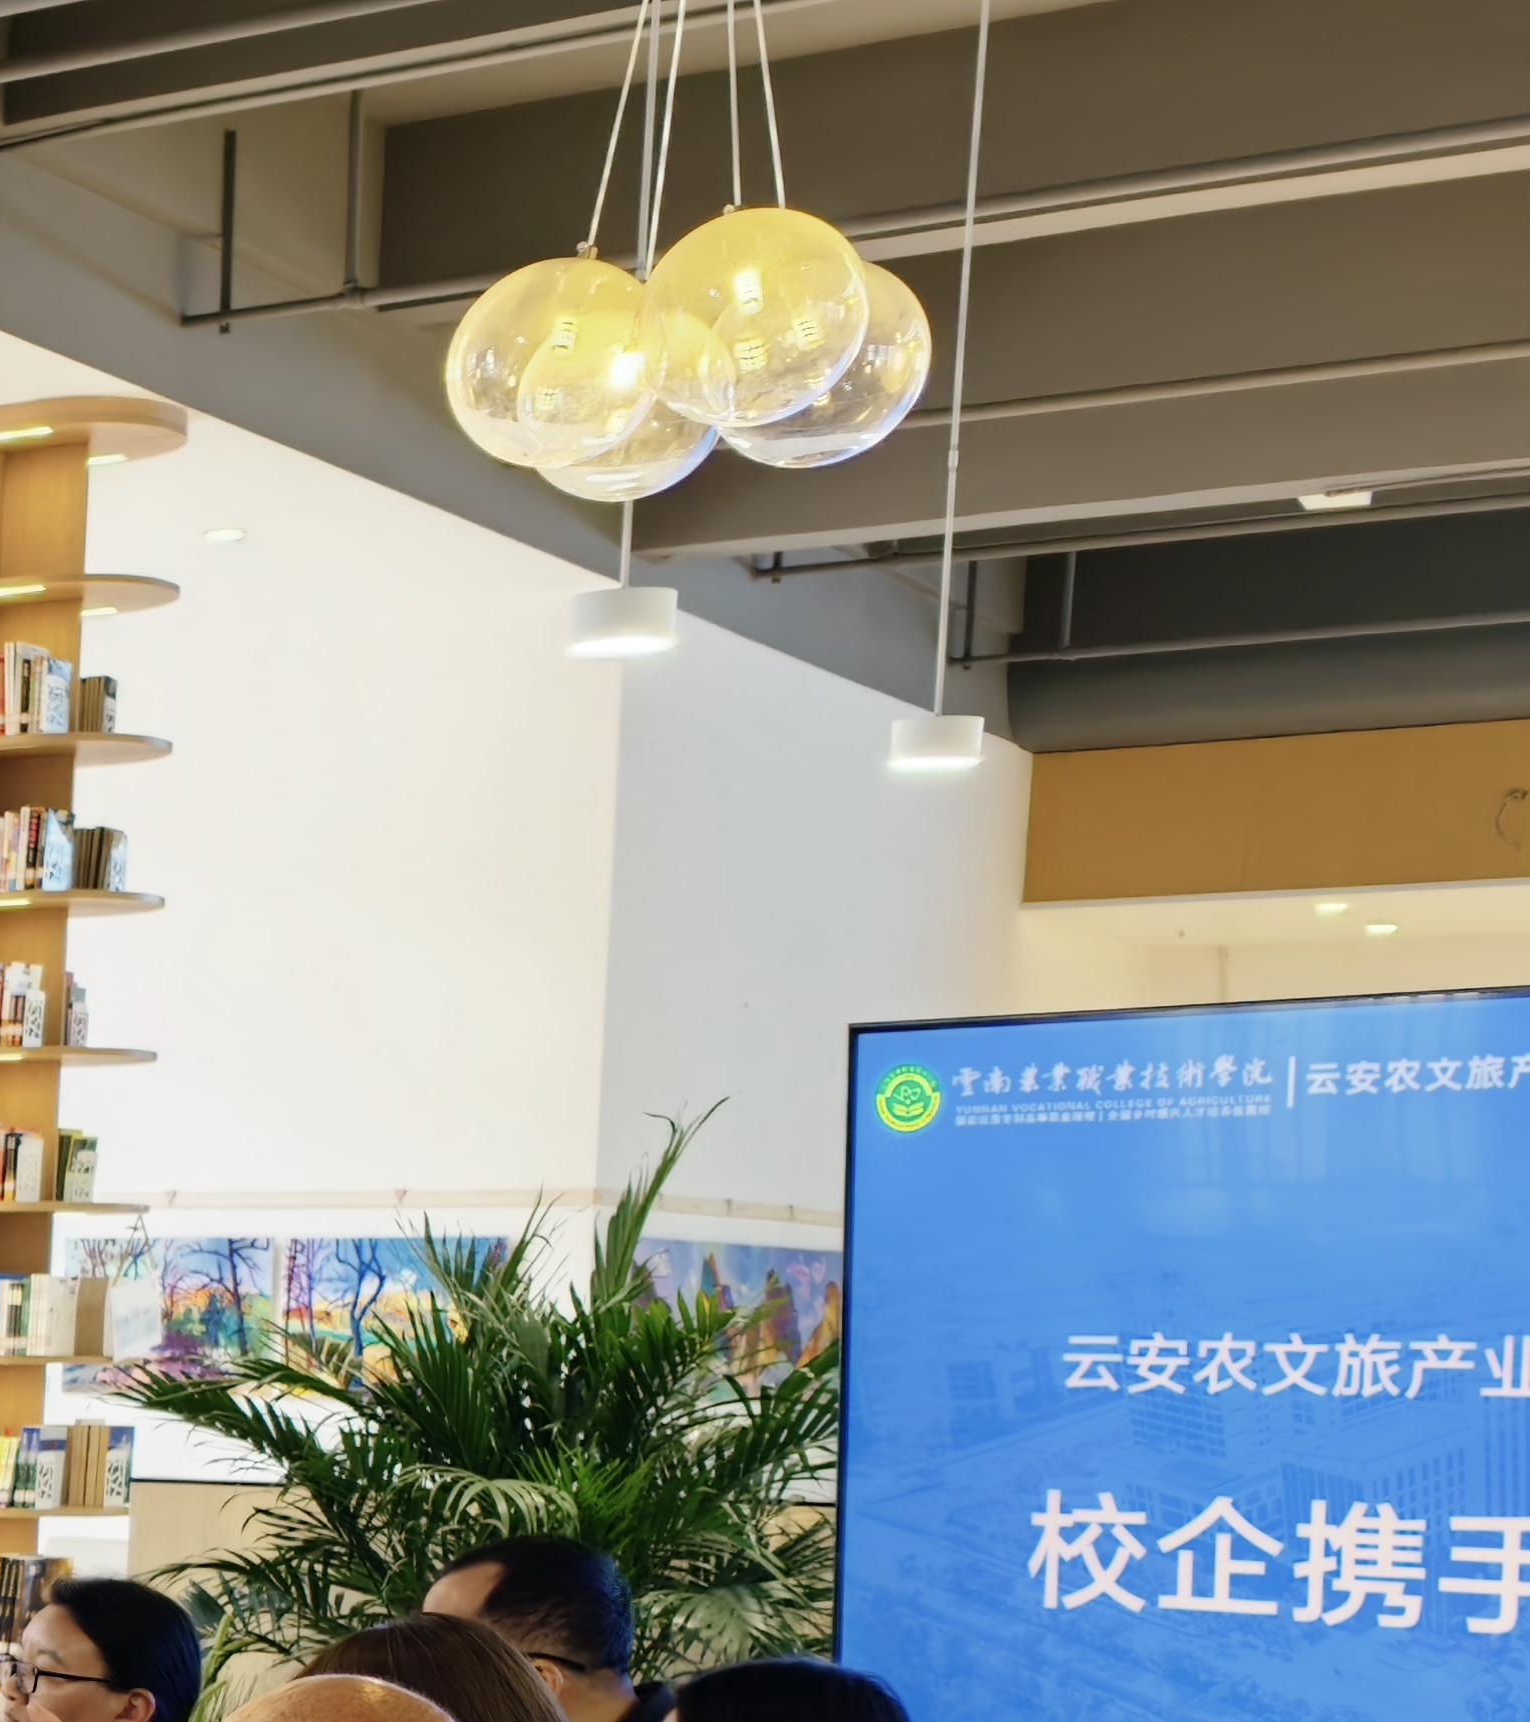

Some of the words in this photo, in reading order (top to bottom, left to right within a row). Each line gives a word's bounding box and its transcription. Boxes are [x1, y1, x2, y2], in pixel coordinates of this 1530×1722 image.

[955, 1104, 1008, 1115] YUNNAN
[1011, 1101, 1091, 1113] VOCATIONAL
[1095, 1098, 1152, 1111] COLLEGE
[1156, 1097, 1175, 1108] OF
[1179, 1094, 1271, 1107] AGRICULTURE
[1062, 1332, 1530, 1399] 云安农文旅产业
[1027, 1488, 1530, 1635] 校企携手
